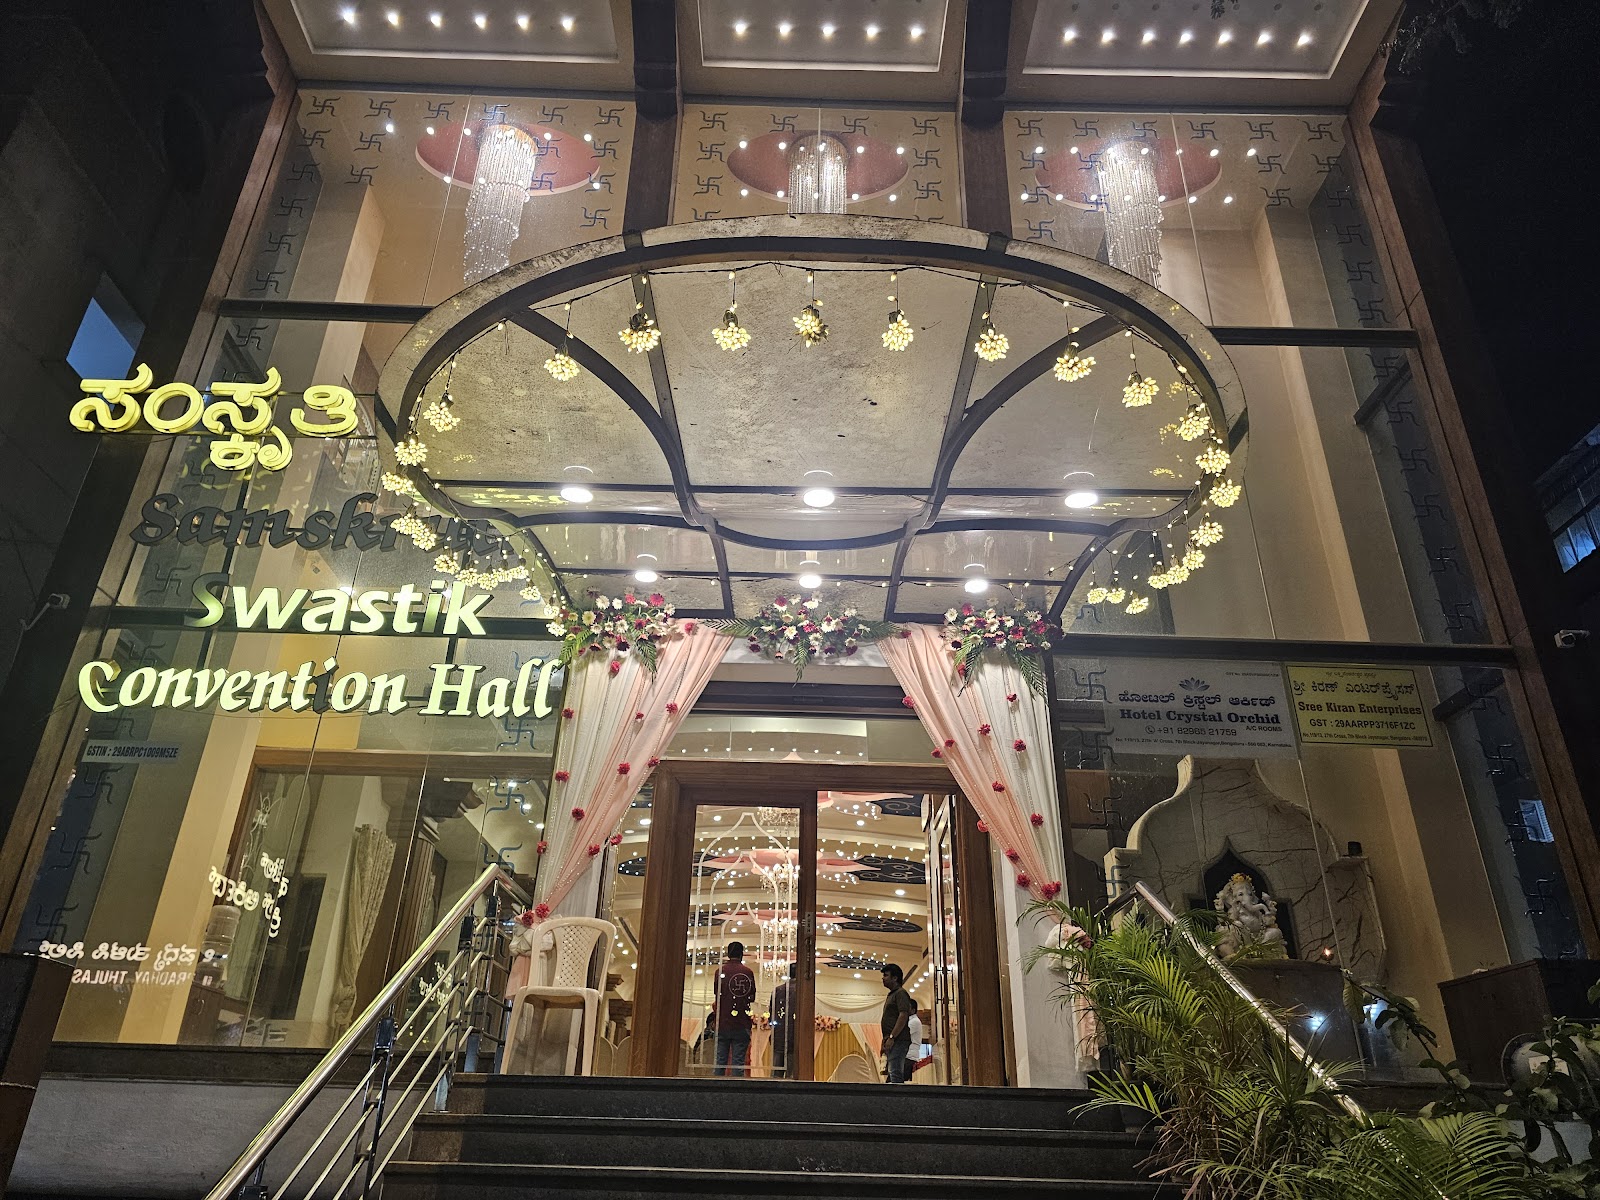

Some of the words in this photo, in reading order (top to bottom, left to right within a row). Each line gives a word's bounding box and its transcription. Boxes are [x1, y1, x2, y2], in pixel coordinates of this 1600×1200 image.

[183, 572, 494, 636] Swastik
[78, 657, 408, 715] Convention
[420, 659, 562, 720] Hall
[1119, 708, 1162, 720] Hotel
[1165, 710, 1223, 723] Crystal
[1227, 712, 1281, 724] Orchid
[1298, 701, 1323, 711] Sree
[1326, 702, 1356, 713] Kiran
[1358, 703, 1422, 716] Enterprises
[1309, 718, 1327, 727] GST
[1157, 727, 1174, 735] +91
[1208, 728, 1237, 736] 21759
[86, 745, 109, 757] GSTIN
